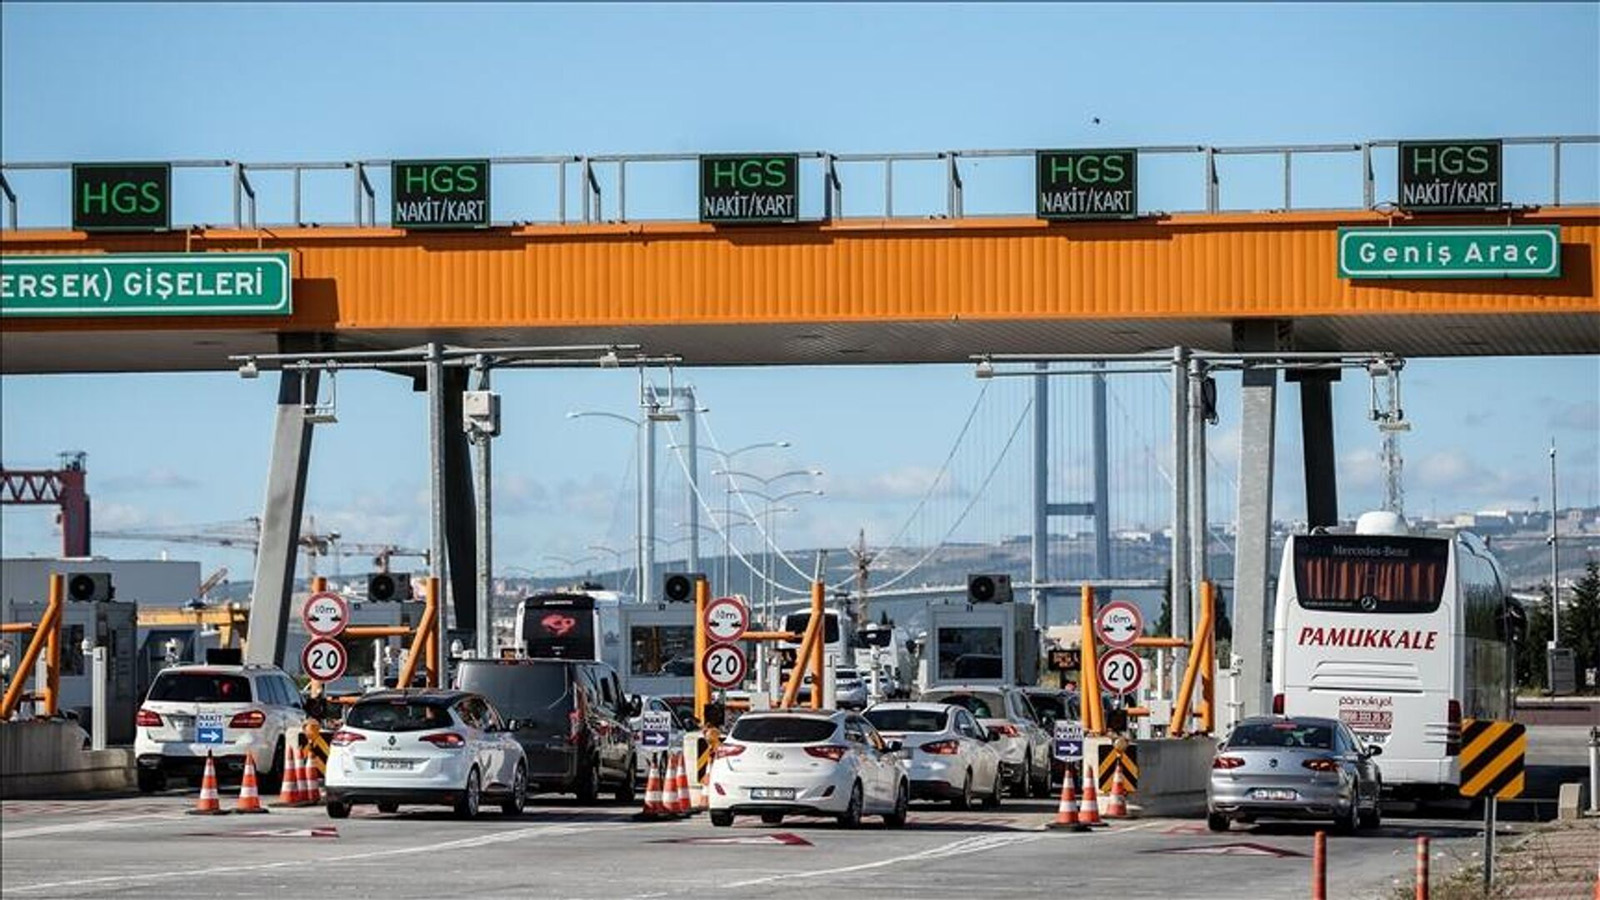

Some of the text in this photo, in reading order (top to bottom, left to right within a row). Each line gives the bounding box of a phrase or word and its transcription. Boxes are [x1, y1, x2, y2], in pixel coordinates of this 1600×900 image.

[1051, 155, 1125, 183] HGS
[1413, 146, 1489, 175] HGS
[406, 166, 478, 193] HGS
[714, 160, 786, 188] HGS
[83, 182, 161, 214] HGS
[705, 190, 794, 217] NAKİT/KART
[1042, 187, 1133, 212] NAKİT/KART
[1403, 178, 1497, 205] NAKİT/KART
[396, 196, 485, 222] NAKİT/KART
[1359, 242, 1538, 266] Geniş Araç
[124, 267, 263, 299] GİŞELERİ
[1332, 546, 1409, 557] Mercedes-Benz
[1298, 627, 1438, 650] PAMUKKALE
[312, 649, 338, 670] 20
[711, 654, 738, 675] 20
[1108, 661, 1134, 681] 20
